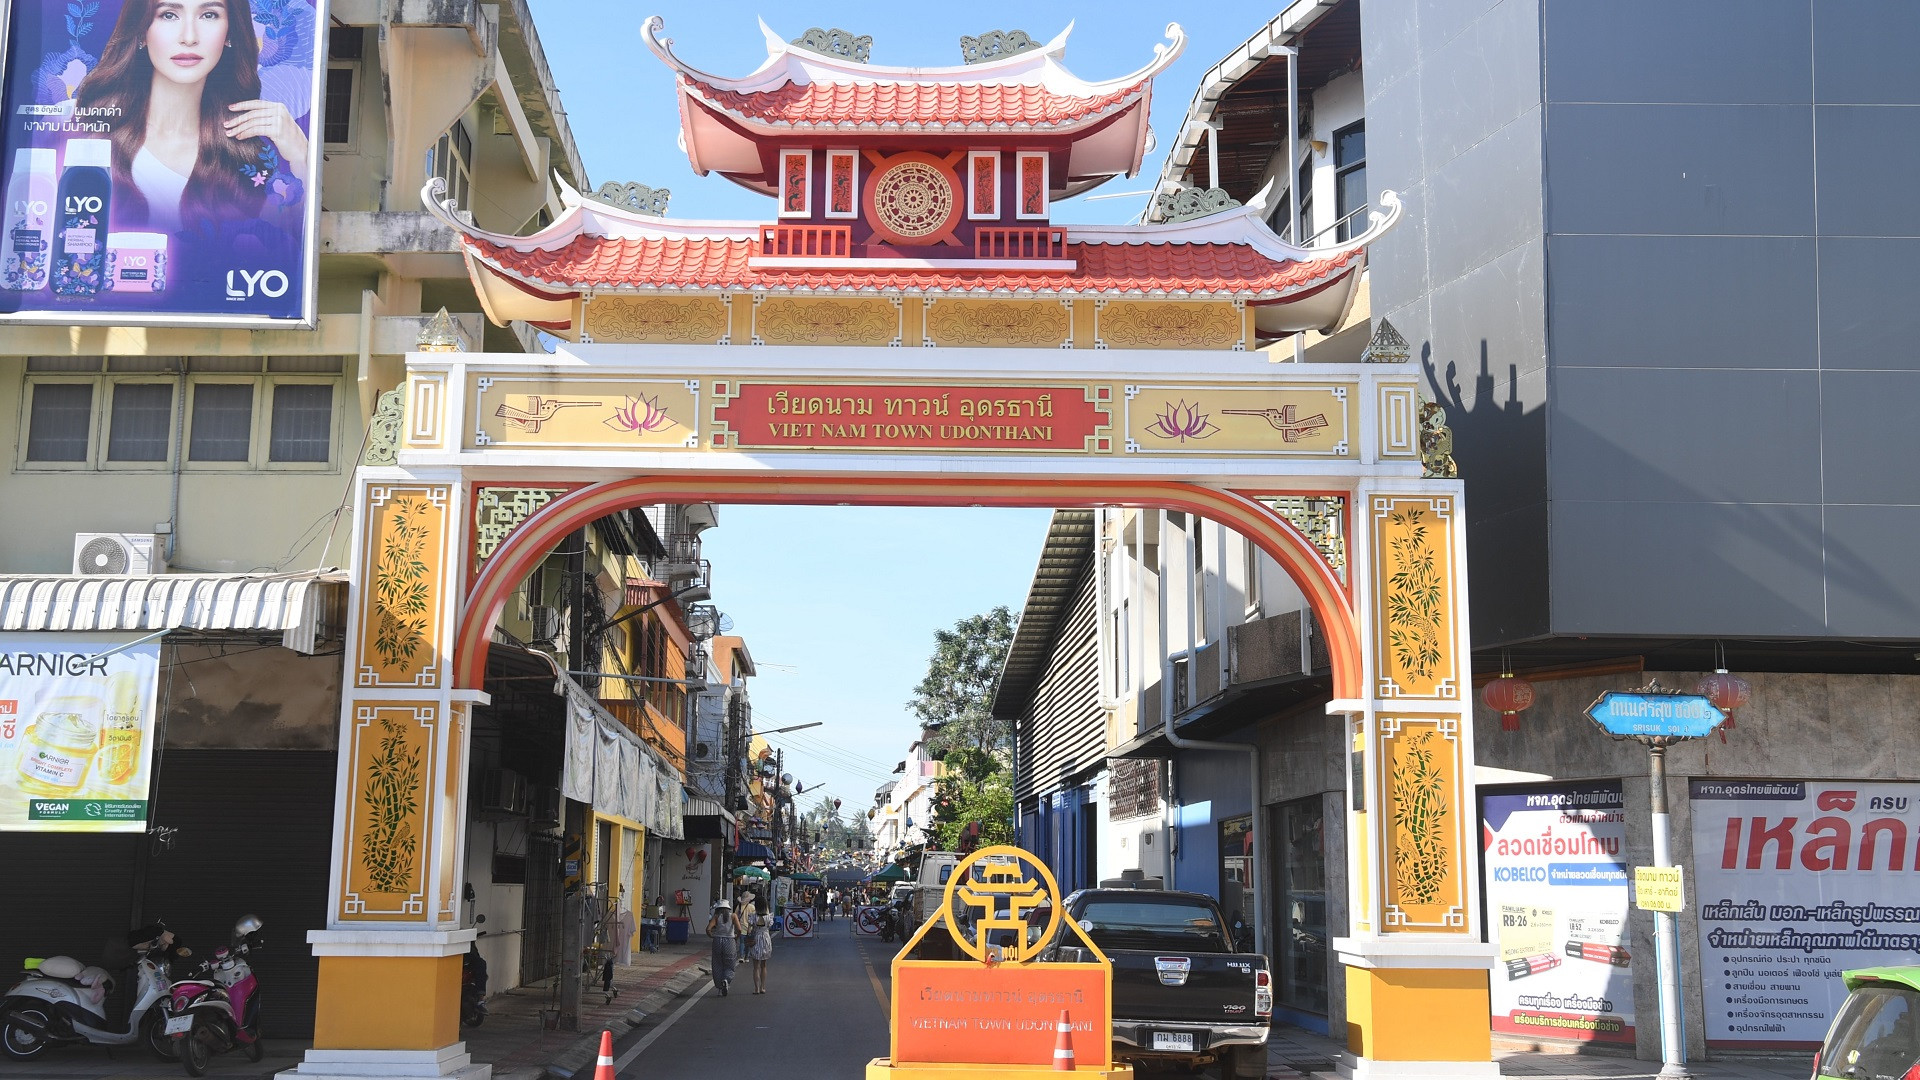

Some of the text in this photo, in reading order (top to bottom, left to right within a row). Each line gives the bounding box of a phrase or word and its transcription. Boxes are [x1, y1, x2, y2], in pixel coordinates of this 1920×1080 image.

[74, 104, 122, 117] ผมดกดำ
[24, 117, 110, 133] เงางาม มีน้ำหนัก
[65, 196, 103, 214] LYO
[226, 269, 289, 298] LYO
[768, 391, 1053, 422] เวียดนาม ทาวน์ อุดรธานี
[768, 423, 1053, 441] VIET NAM TOWN UDONTHANI
[1633, 724, 1660, 732] SRISUK
[1667, 725, 1680, 733] SOI
[1701, 784, 1908, 810] หจก.อุดรไทยพิพัฒน์ ครบ
[35, 803, 70, 811] VEGAN
[1721, 790, 1920, 872] เหล็ก
[1498, 825, 1619, 856] ลวดเชื่อมโกเบ
[1494, 866, 1546, 882] KOBELCO
[1703, 902, 1765, 920] เหล็กเส้น
[1503, 914, 1528, 927] RB-26
[1709, 929, 1920, 952] จำหน่ายเหล็กคุณภาพได้มาตรา
[1776, 956, 1800, 964] ประปา
[1803, 956, 1831, 965] ทุกชนิด
[1731, 969, 1754, 978] ลูกปืน
[1758, 969, 1789, 977] มอเตอร์
[1733, 980, 1801, 991] สายเชื่อม สายพาน
[1733, 994, 1809, 1005] เครื่องมือการเกษตร
[1735, 1008, 1824, 1020] เครื่องจักรอุตสาหกรรม
[910, 1016, 1094, 1032] VIETNAM TOWN UDONTANI
[1736, 1024, 1786, 1034] อุปกรณ์ไฟฟ้า
